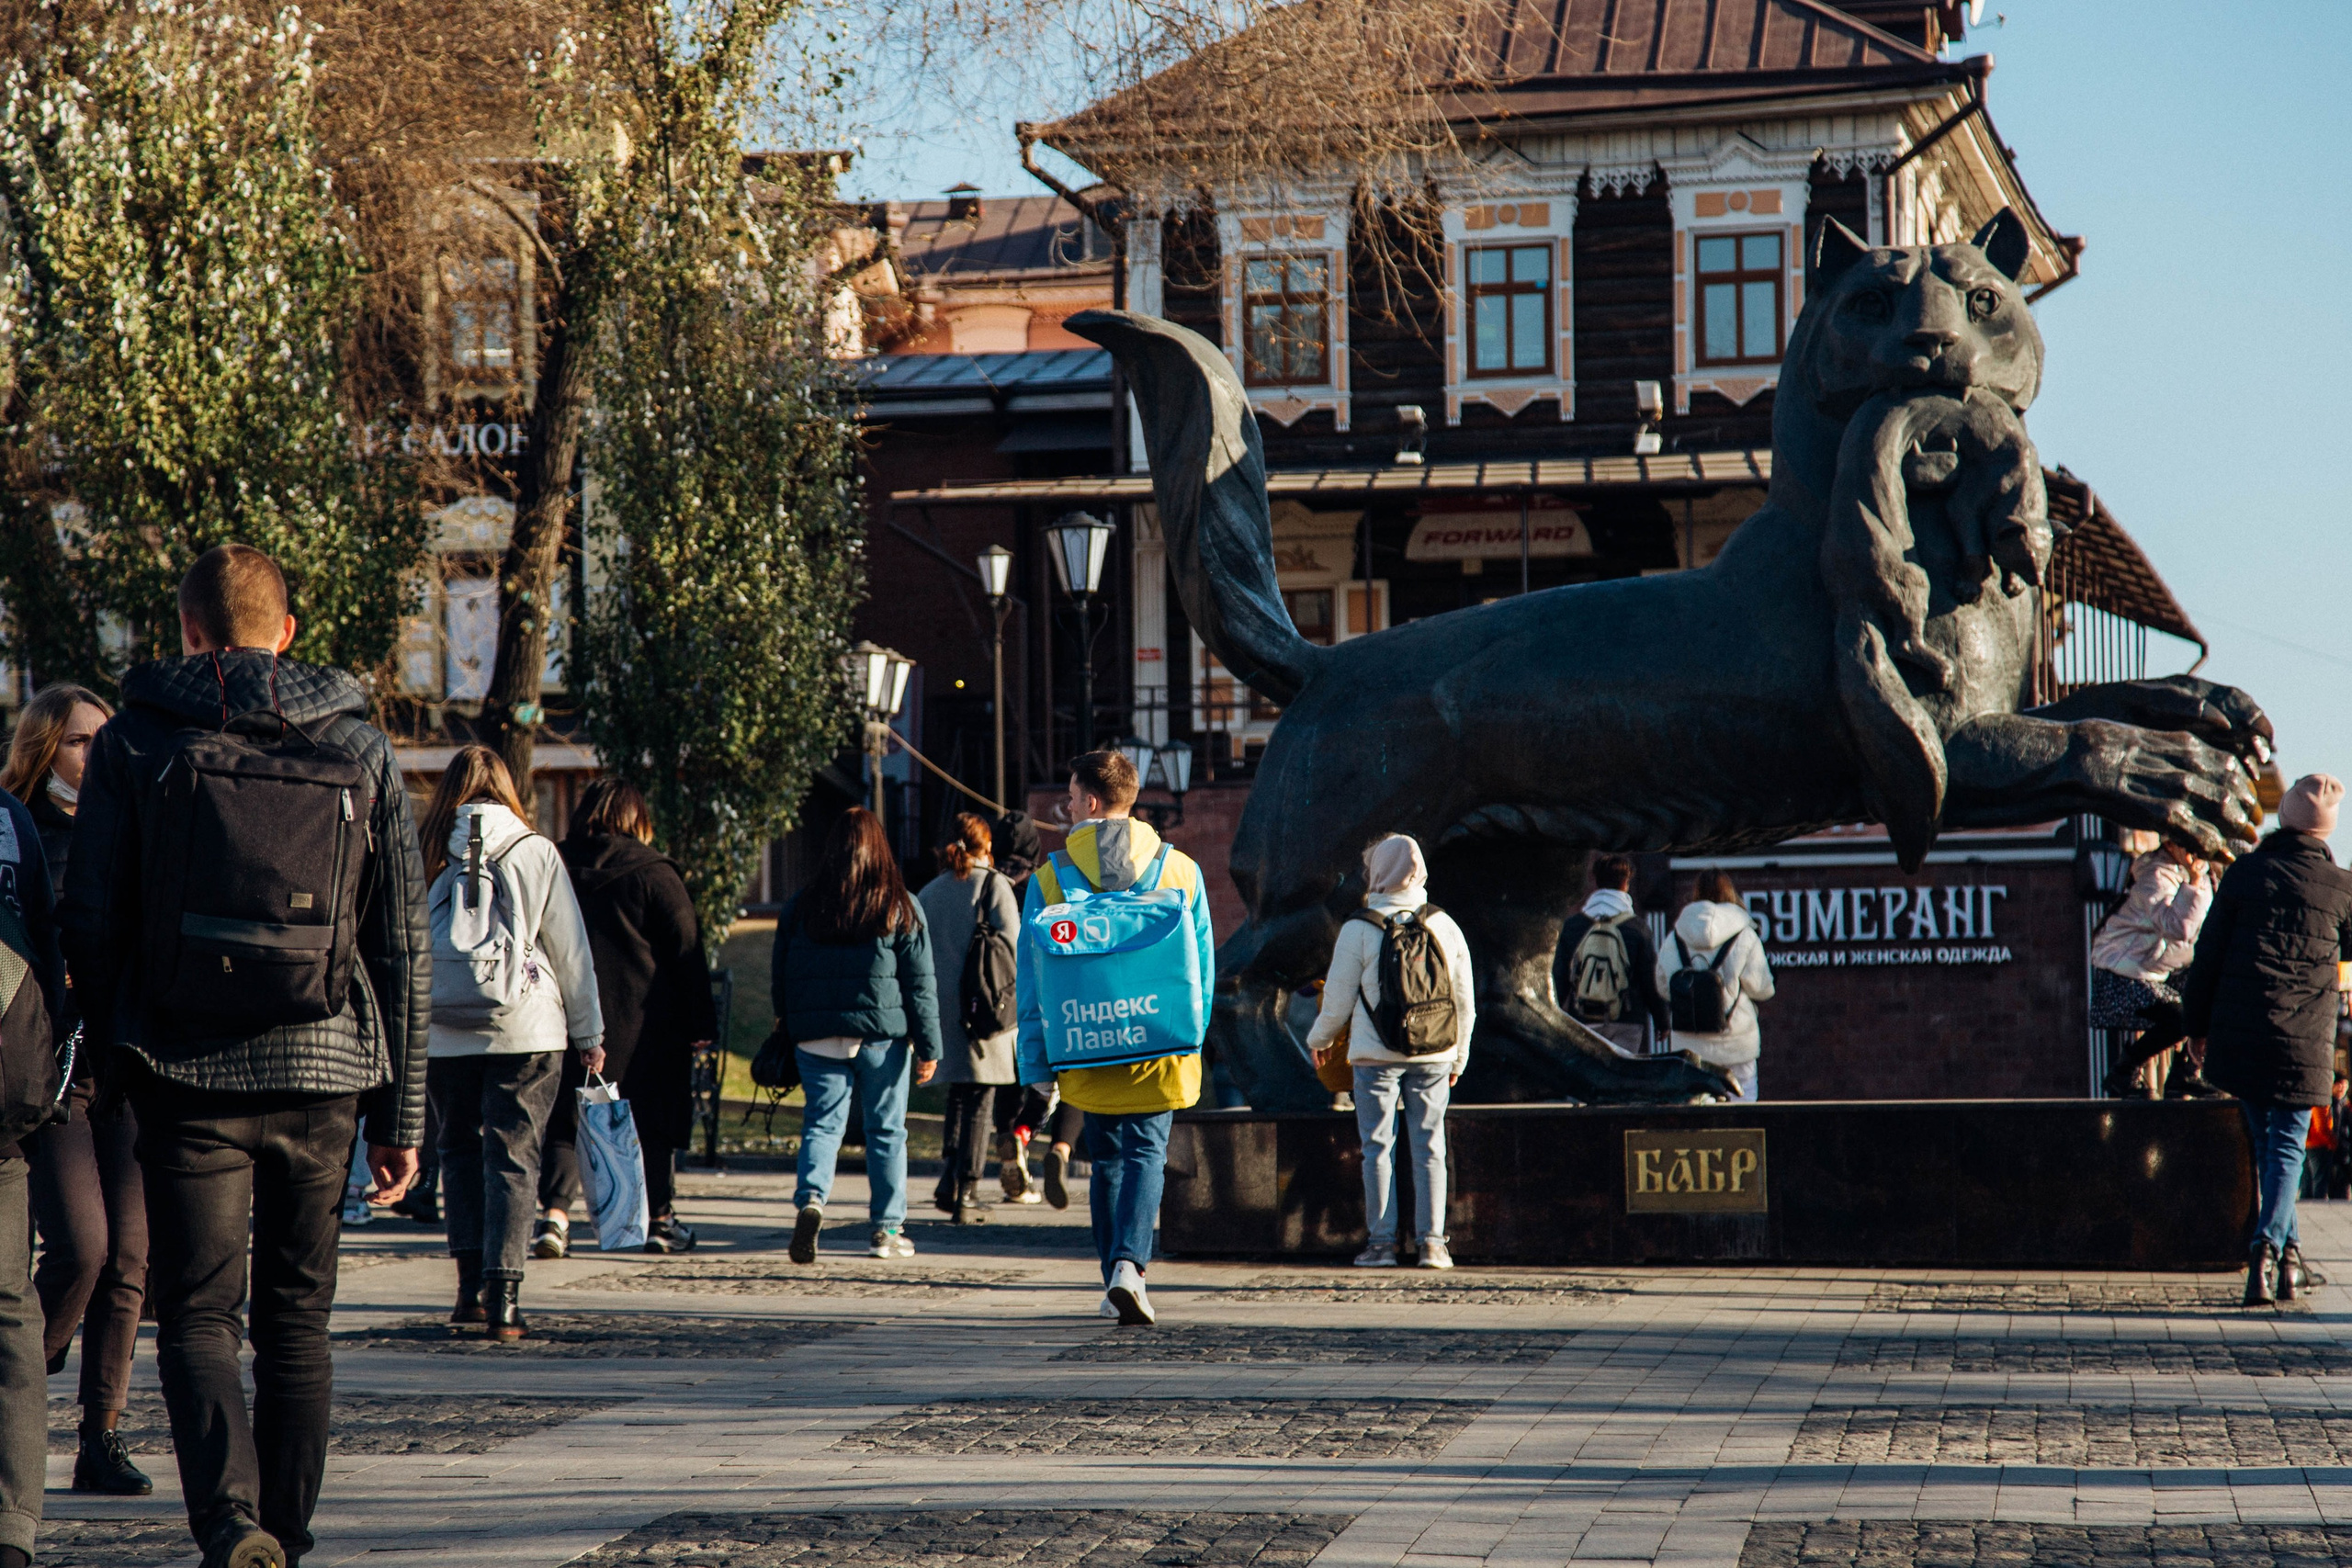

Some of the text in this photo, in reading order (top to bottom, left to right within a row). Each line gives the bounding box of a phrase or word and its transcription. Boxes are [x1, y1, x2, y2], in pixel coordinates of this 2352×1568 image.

[1423, 525, 1576, 545] FORWARD
[1741, 885, 2007, 943] БУМЕРАНГ
[1057, 922, 1070, 940] Я
[1834, 950, 1846, 965] И
[1851, 947, 1932, 965] ЖЕНСКАЯ
[1937, 945, 2013, 965] ОДЕЖДА
[1061, 994, 1159, 1024] Яндекс
[1066, 1025, 1148, 1053] Лавка
[1634, 1148, 1758, 1192] БАБР
